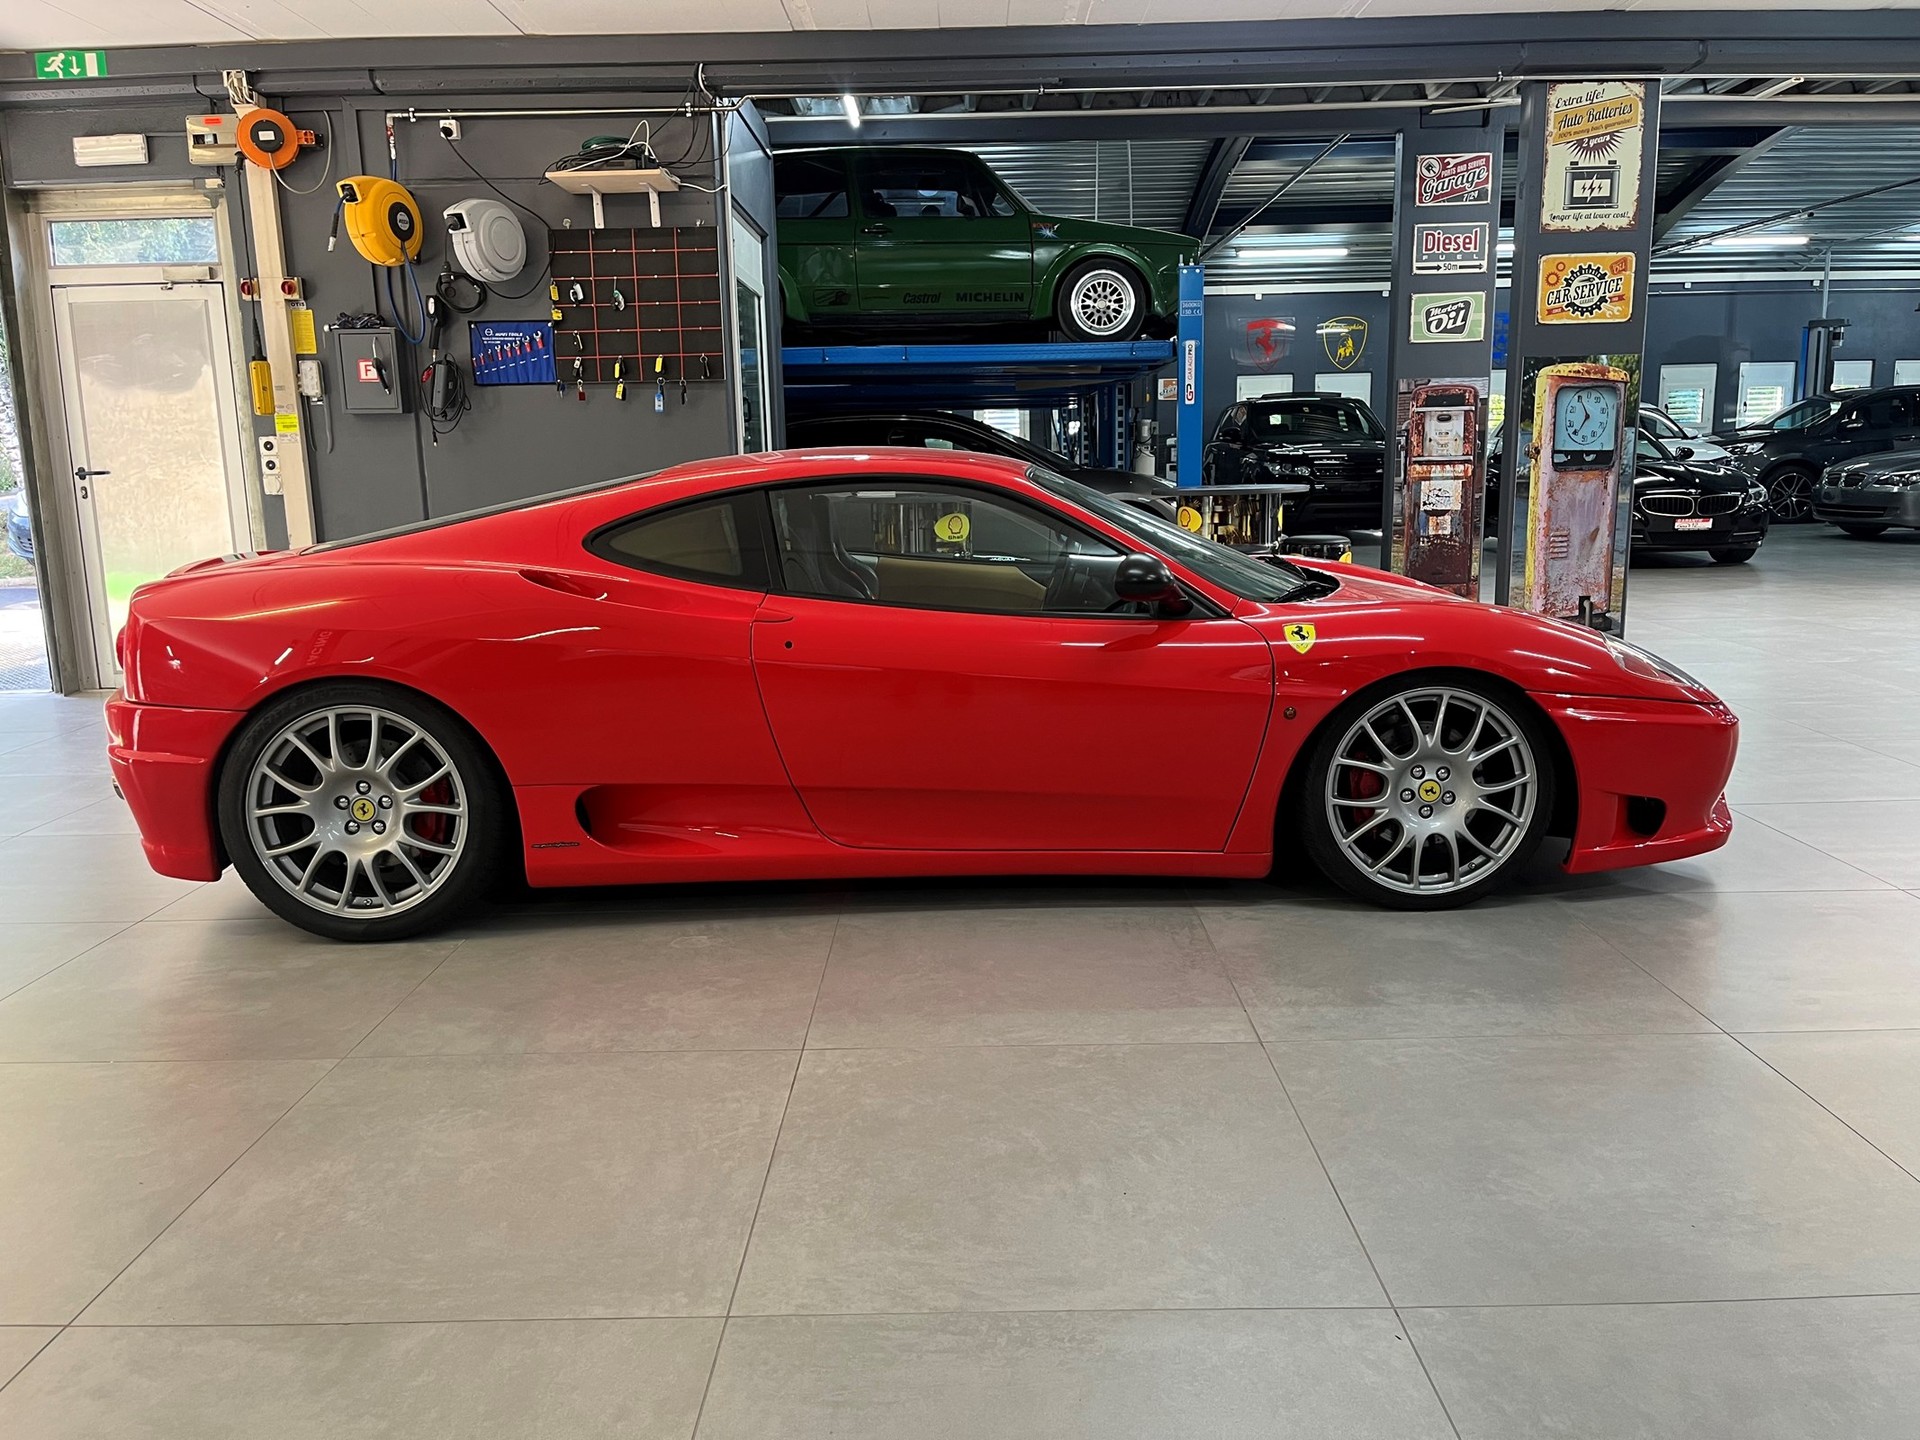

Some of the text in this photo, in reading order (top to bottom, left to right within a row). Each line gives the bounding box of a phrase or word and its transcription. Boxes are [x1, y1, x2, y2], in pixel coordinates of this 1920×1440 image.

[1556, 88, 1605, 108] Extra life!
[1558, 102, 1633, 131] Auto Batteries
[1583, 134, 1610, 147] 2 years
[1441, 158, 1486, 178] PARTS AND SERVICE
[1422, 166, 1488, 202] Garage
[1463, 190, 1479, 202] 7/24
[1573, 213, 1583, 221] life
[1423, 227, 1480, 254] Diesel
[1443, 263, 1458, 271] 50m
[903, 292, 1024, 304] Castrol MICHELIN
[1547, 277, 1623, 305] CAR SERVICE
[1429, 302, 1465, 317] Motor
[1428, 309, 1465, 333] Oil
[364, 364, 374, 376] F
